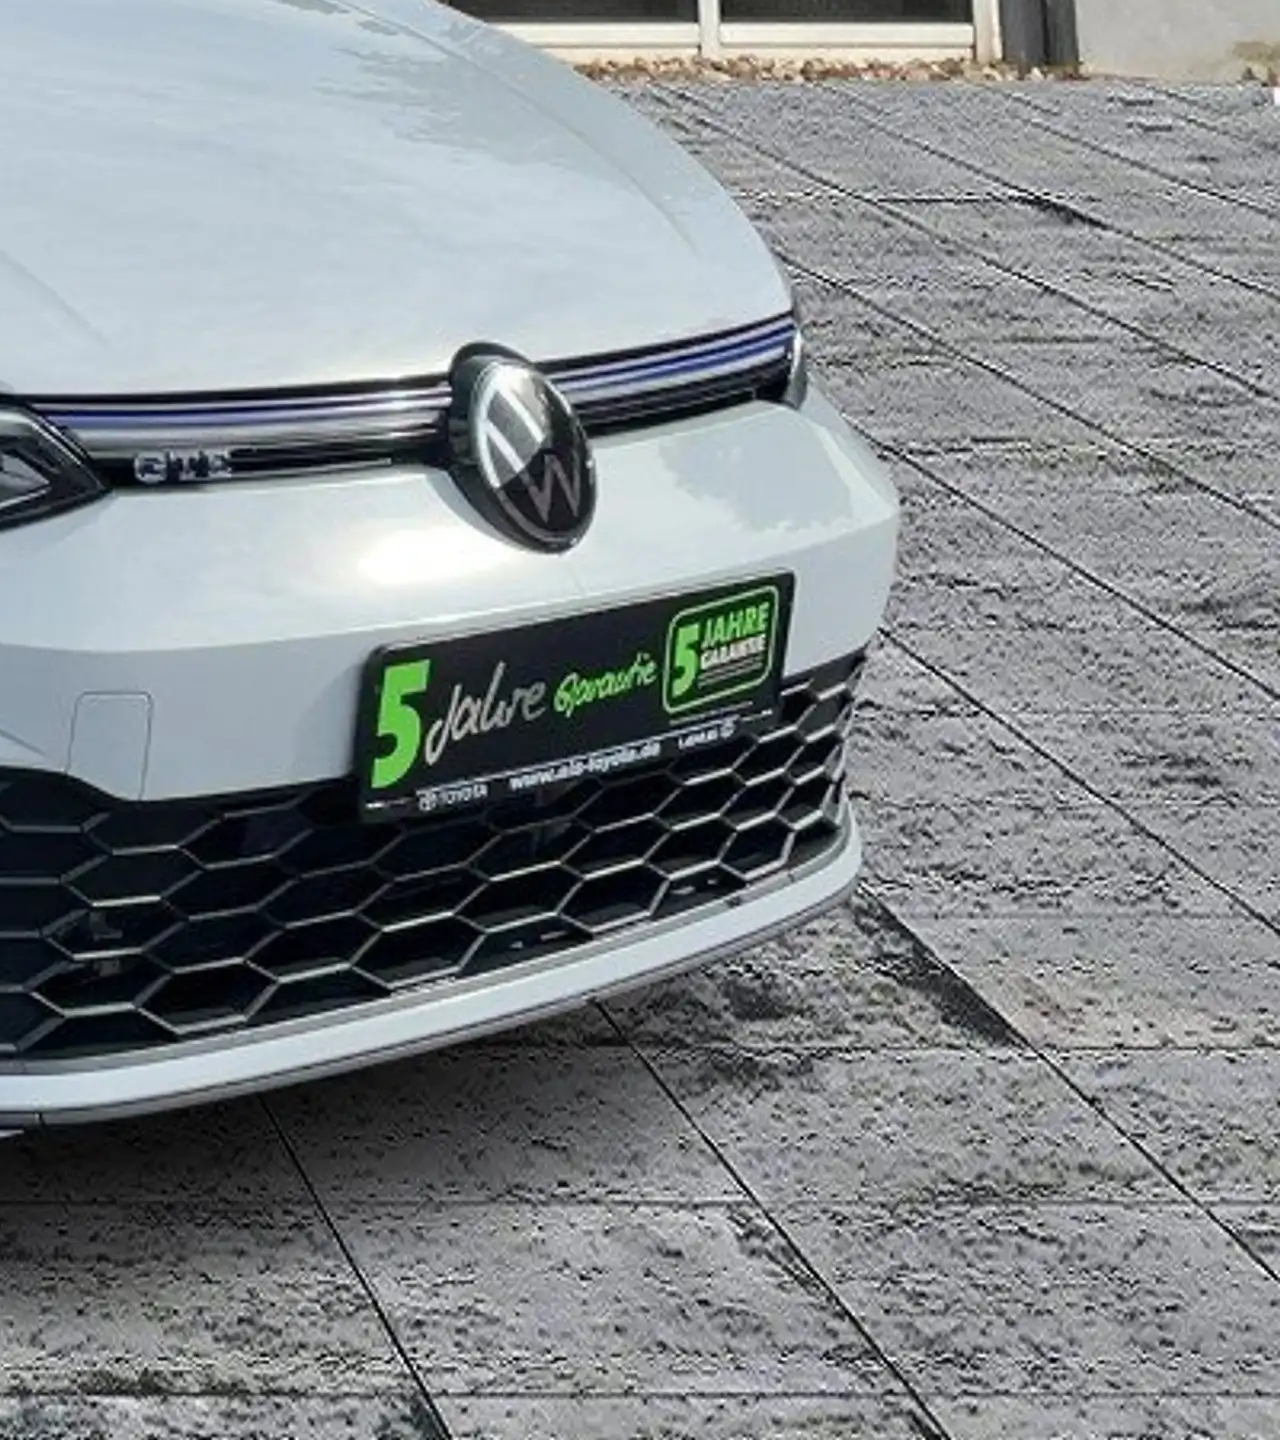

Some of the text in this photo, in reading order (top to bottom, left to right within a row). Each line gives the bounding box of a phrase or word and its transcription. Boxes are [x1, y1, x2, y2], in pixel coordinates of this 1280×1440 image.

[133, 448, 232, 482] GTE
[701, 601, 770, 649] JAHRE
[671, 622, 701, 698] 5
[370, 653, 658, 789] 5 Jahre Garantie
[439, 783, 489, 809] TOYOTA
